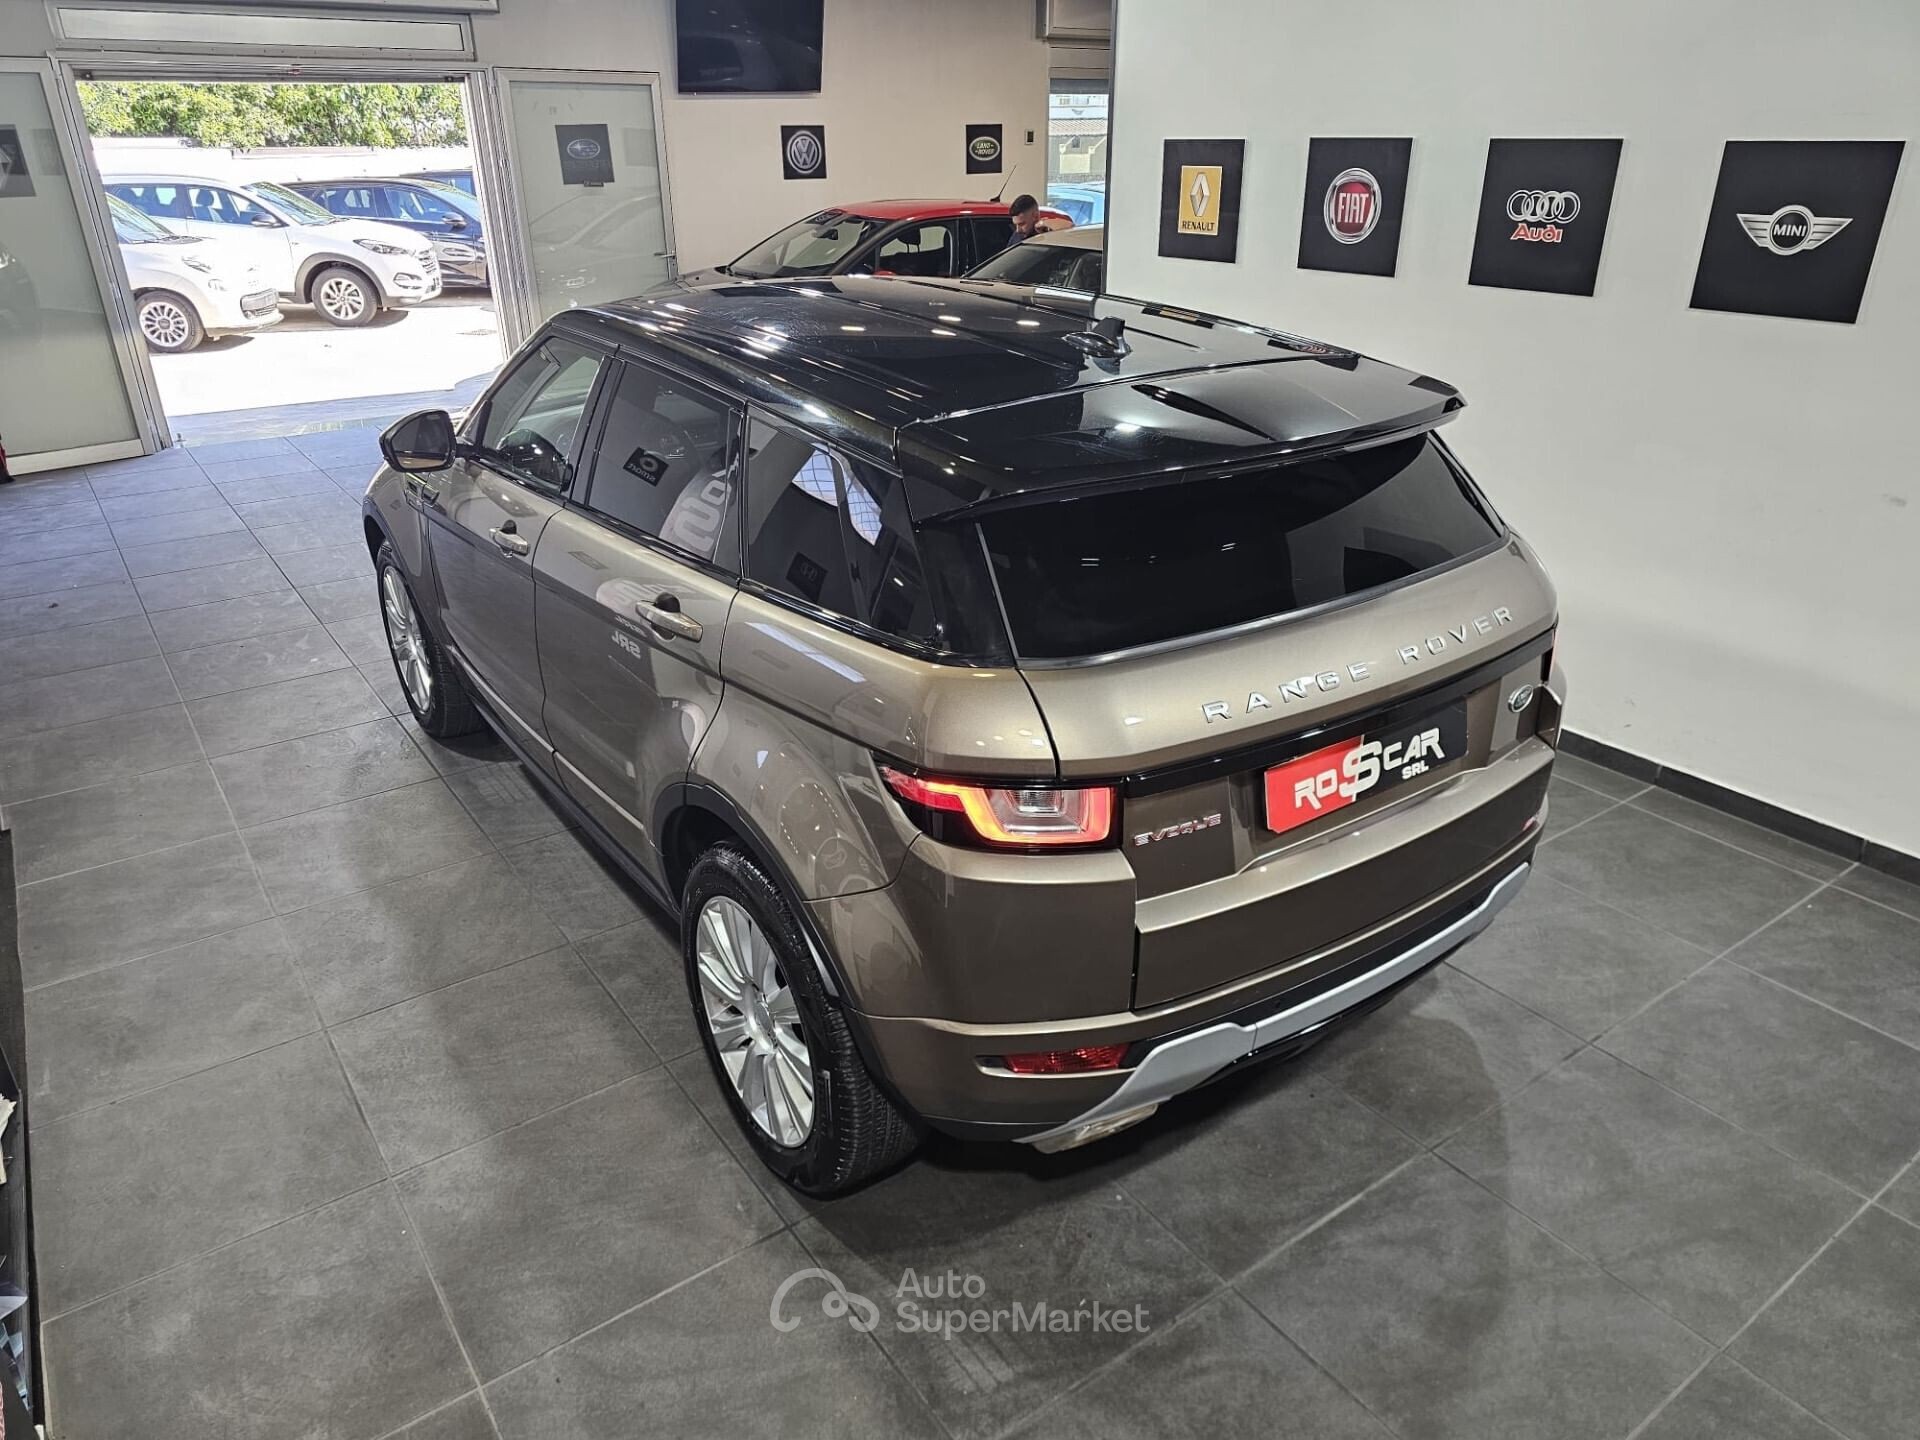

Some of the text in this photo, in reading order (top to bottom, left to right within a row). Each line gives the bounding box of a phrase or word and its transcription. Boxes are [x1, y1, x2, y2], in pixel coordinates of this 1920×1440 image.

[1337, 193, 1370, 224] FIAT
[1182, 220, 1216, 232] RENAULT
[1510, 223, 1563, 244] Audi
[1772, 223, 1807, 238] MINI
[1202, 606, 1513, 723] RANGE ROVER
[1401, 760, 1430, 780] SRL
